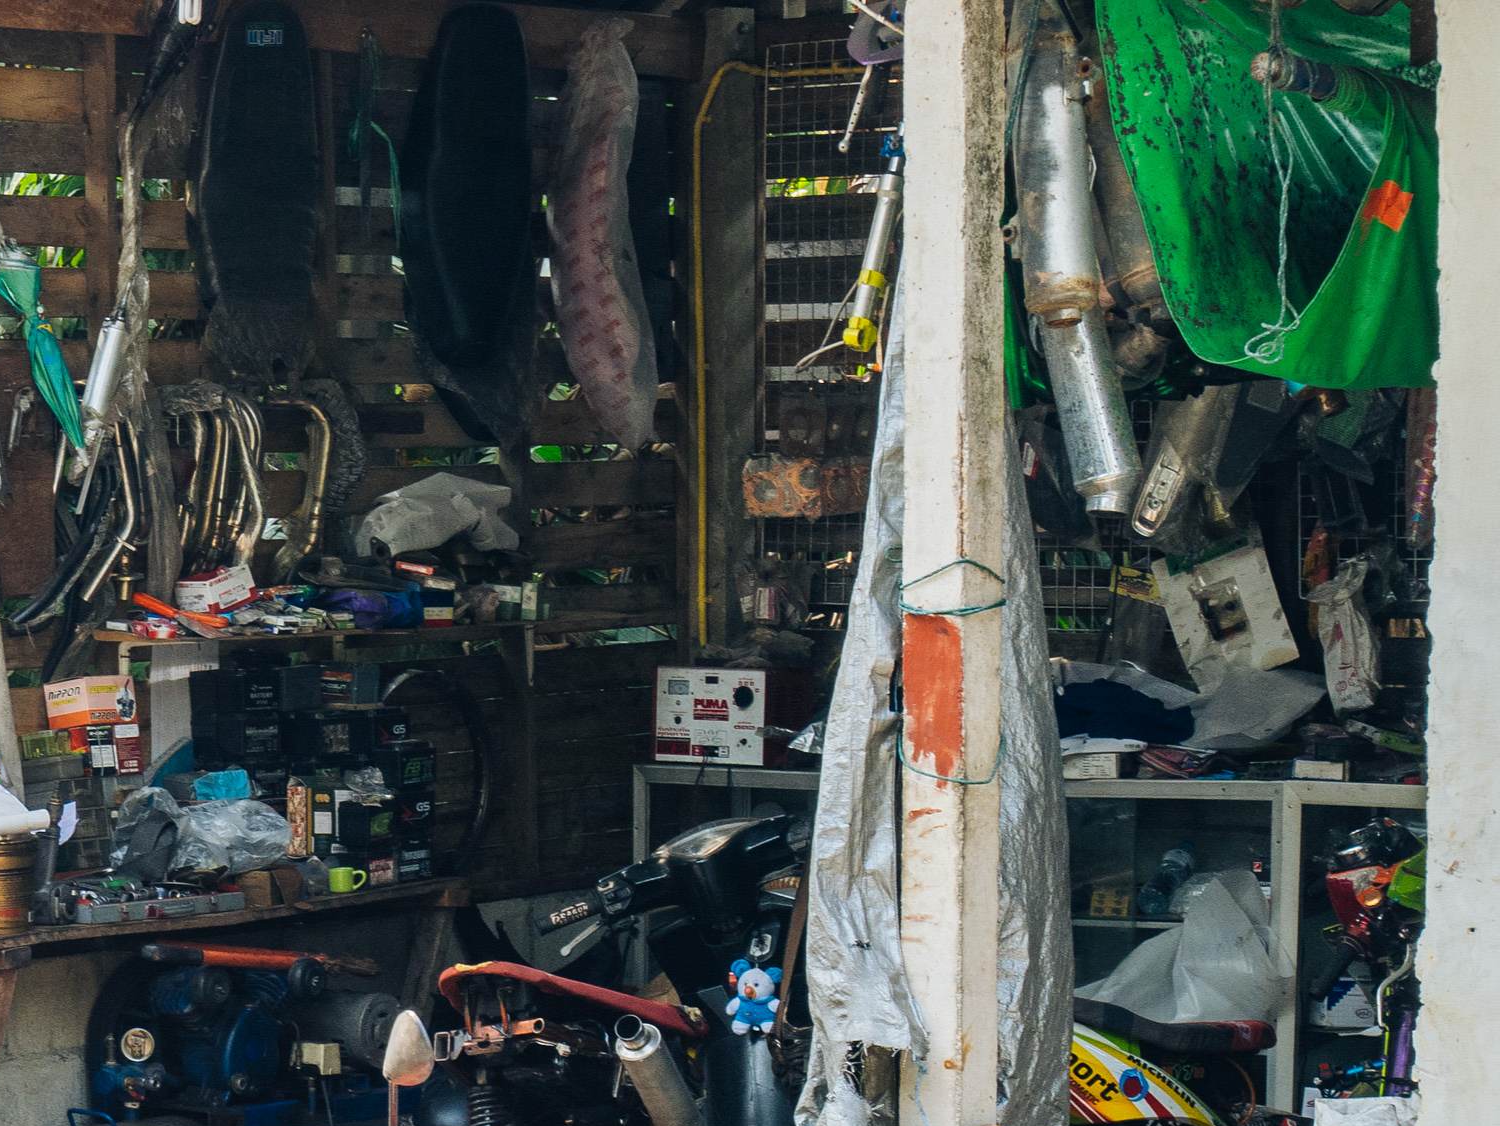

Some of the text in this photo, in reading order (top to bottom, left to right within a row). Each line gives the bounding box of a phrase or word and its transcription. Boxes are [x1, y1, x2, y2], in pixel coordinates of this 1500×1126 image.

[693, 698, 729, 710] PUMA
[415, 801, 431, 812] GS
[1127, 1054, 1197, 1108] MICHELIN
